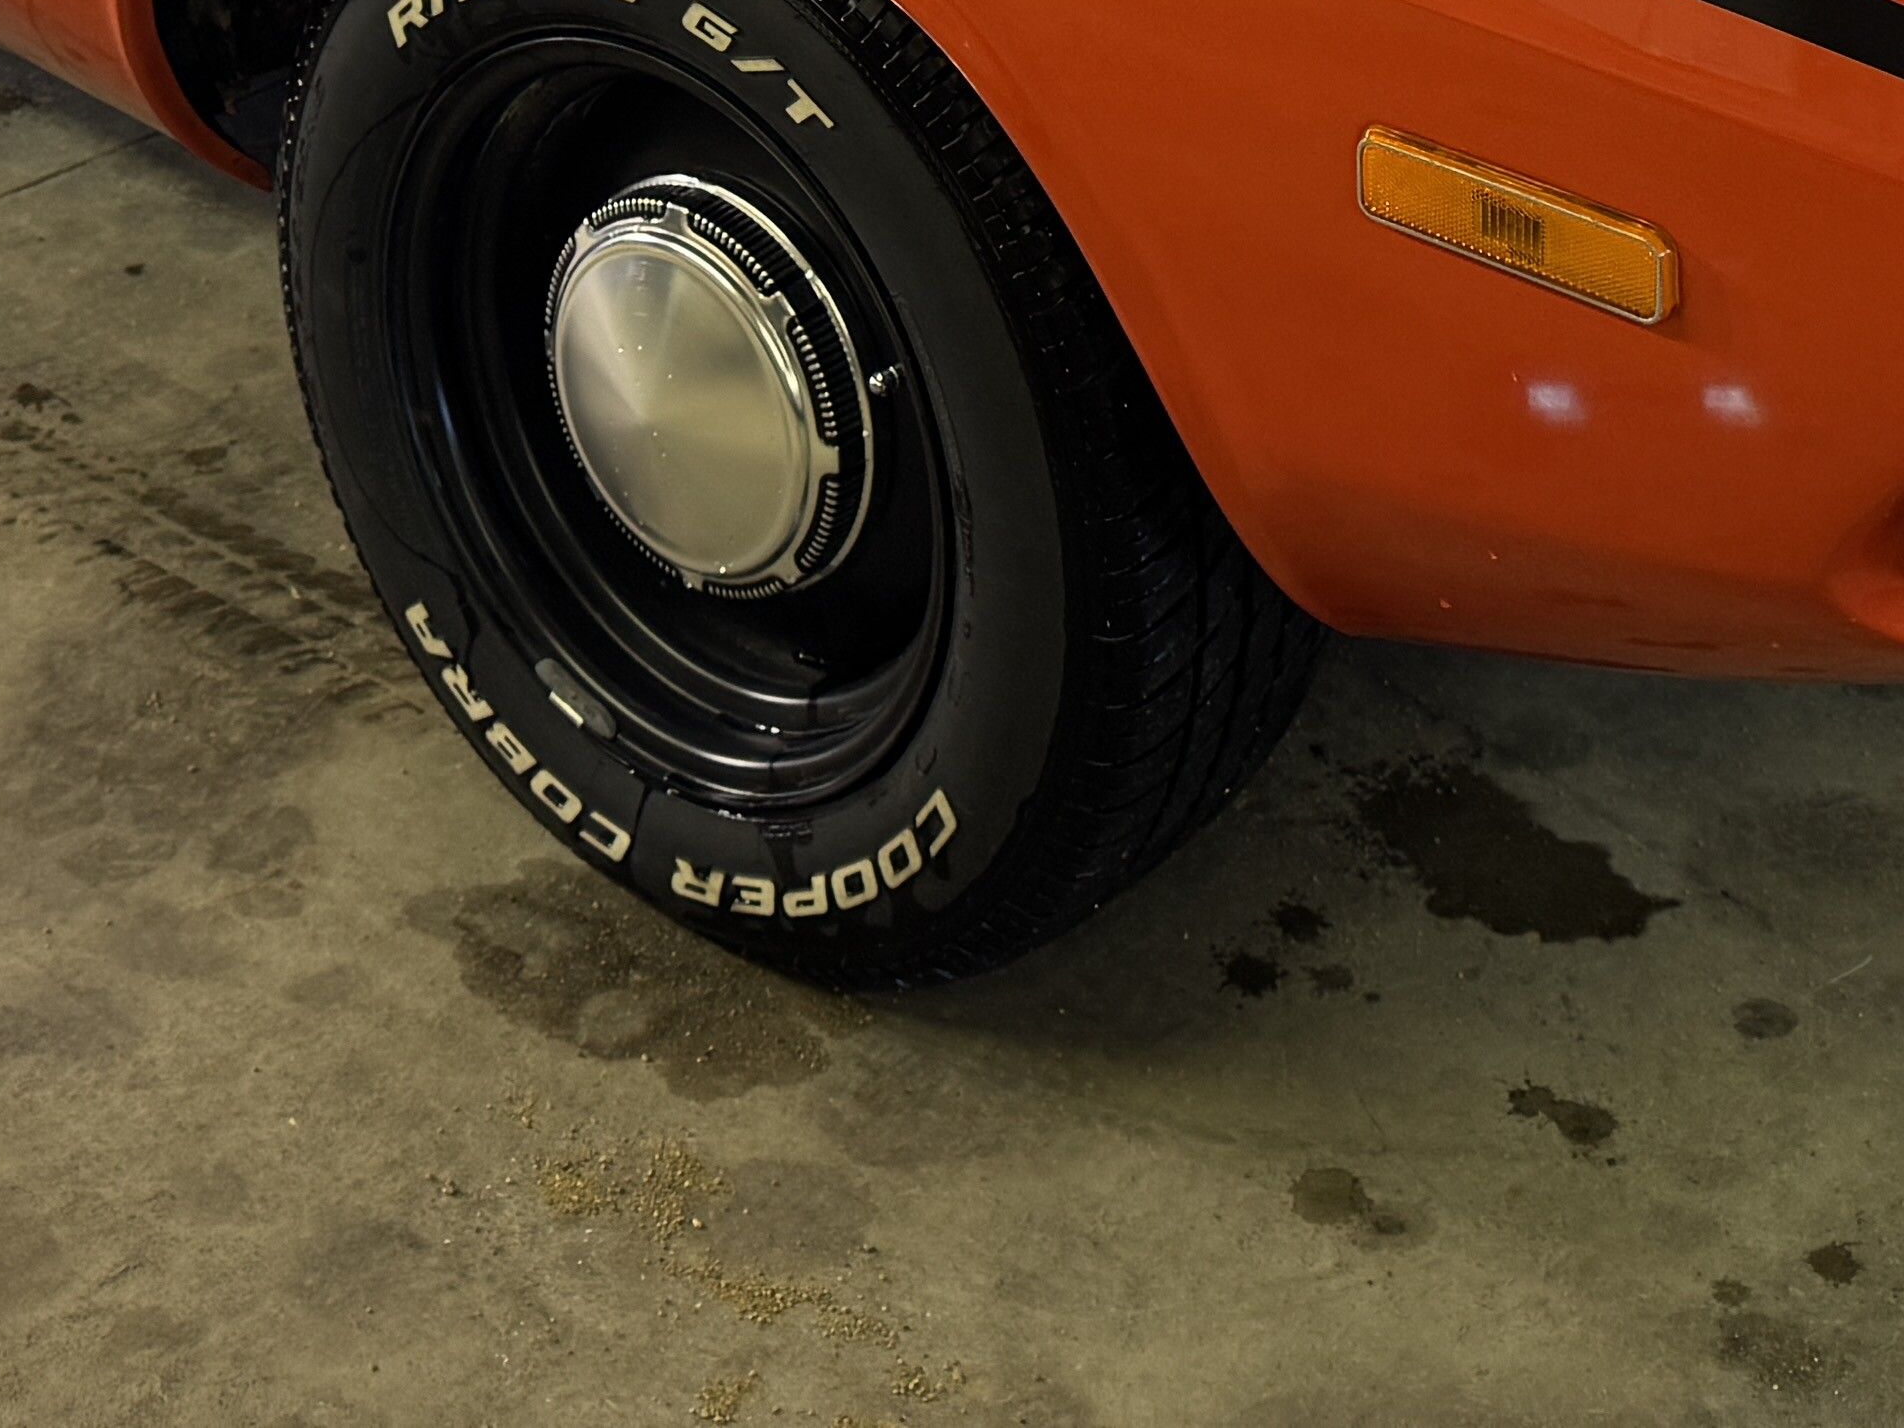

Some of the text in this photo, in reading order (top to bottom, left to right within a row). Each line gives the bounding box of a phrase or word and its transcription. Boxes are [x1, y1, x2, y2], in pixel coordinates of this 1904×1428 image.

[681, 2, 836, 133] G/T
[402, 602, 633, 865] COBRA
[669, 788, 960, 919] COOPER
